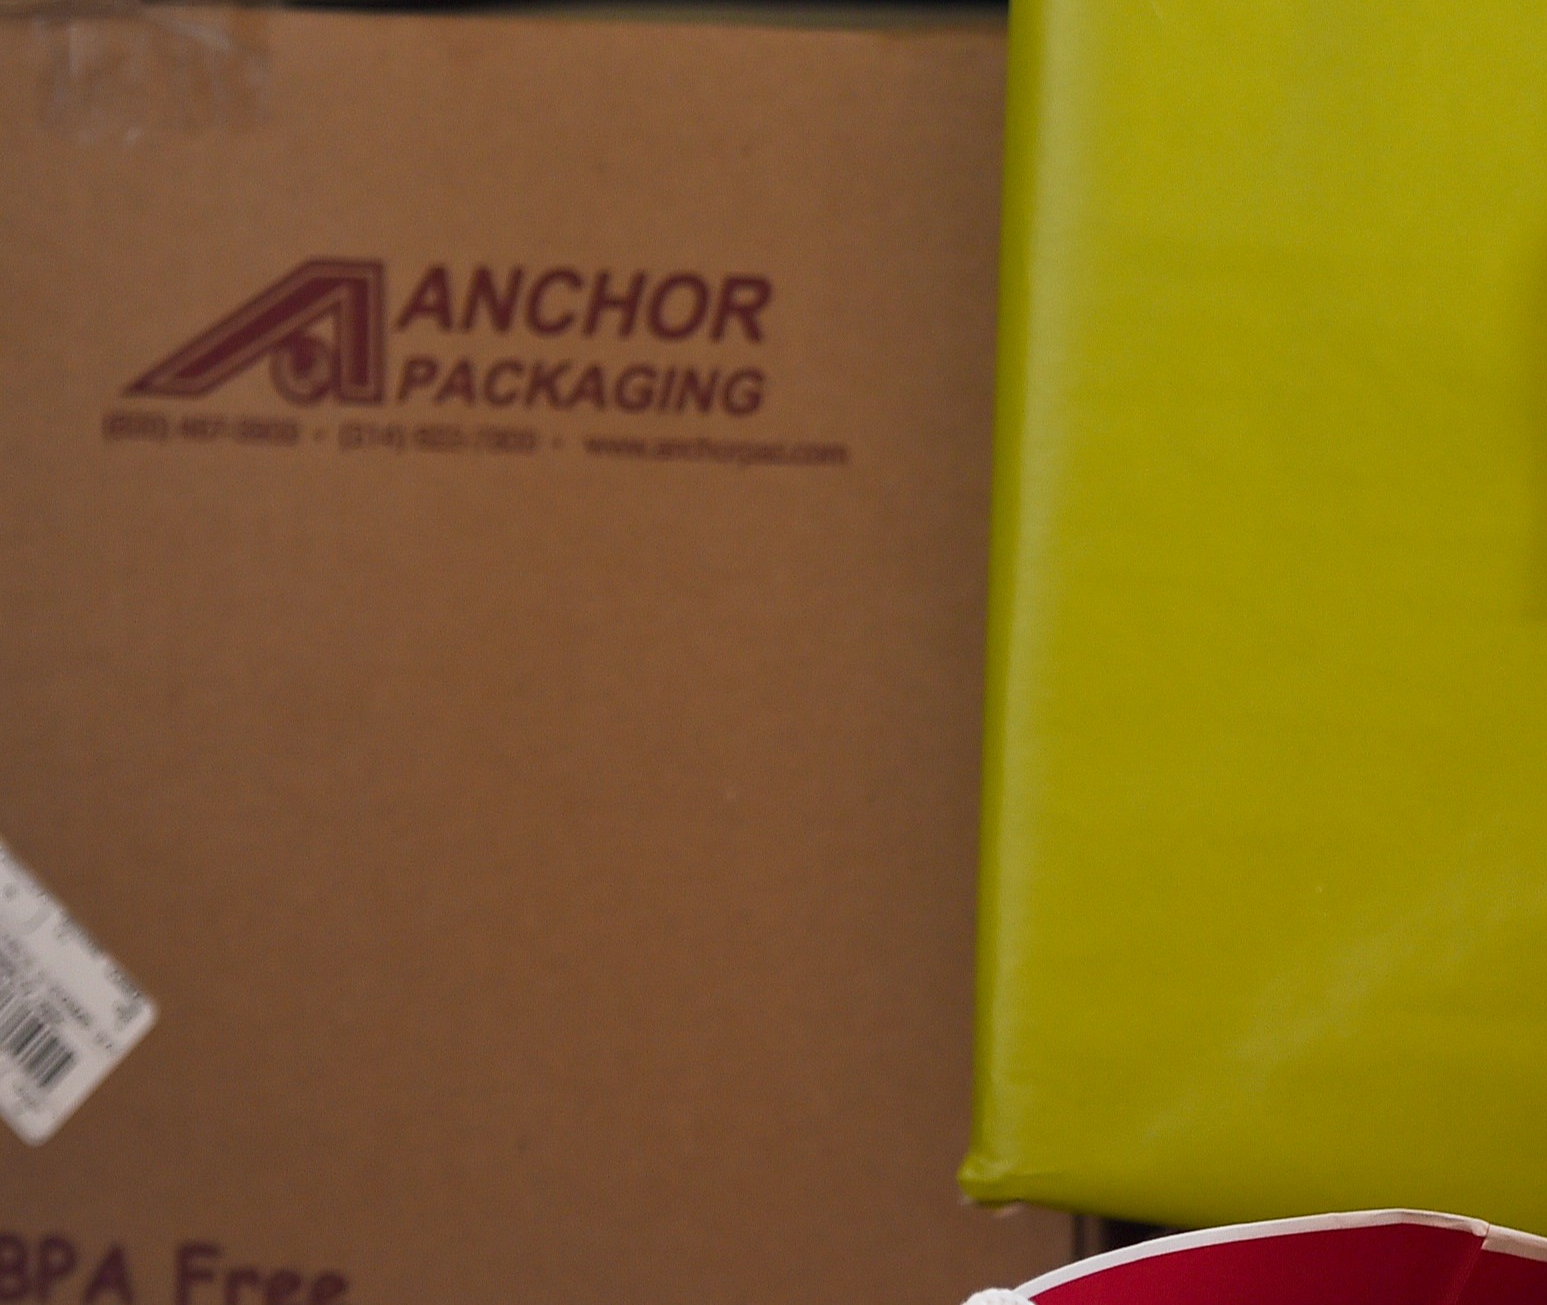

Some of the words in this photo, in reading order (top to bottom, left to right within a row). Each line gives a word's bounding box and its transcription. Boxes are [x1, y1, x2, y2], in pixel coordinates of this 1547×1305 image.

[397, 263, 774, 344] ANCHOR
[399, 355, 768, 417] PACKAGING
[0, 1230, 138, 1305] BPA
[174, 1238, 353, 1305] Free
